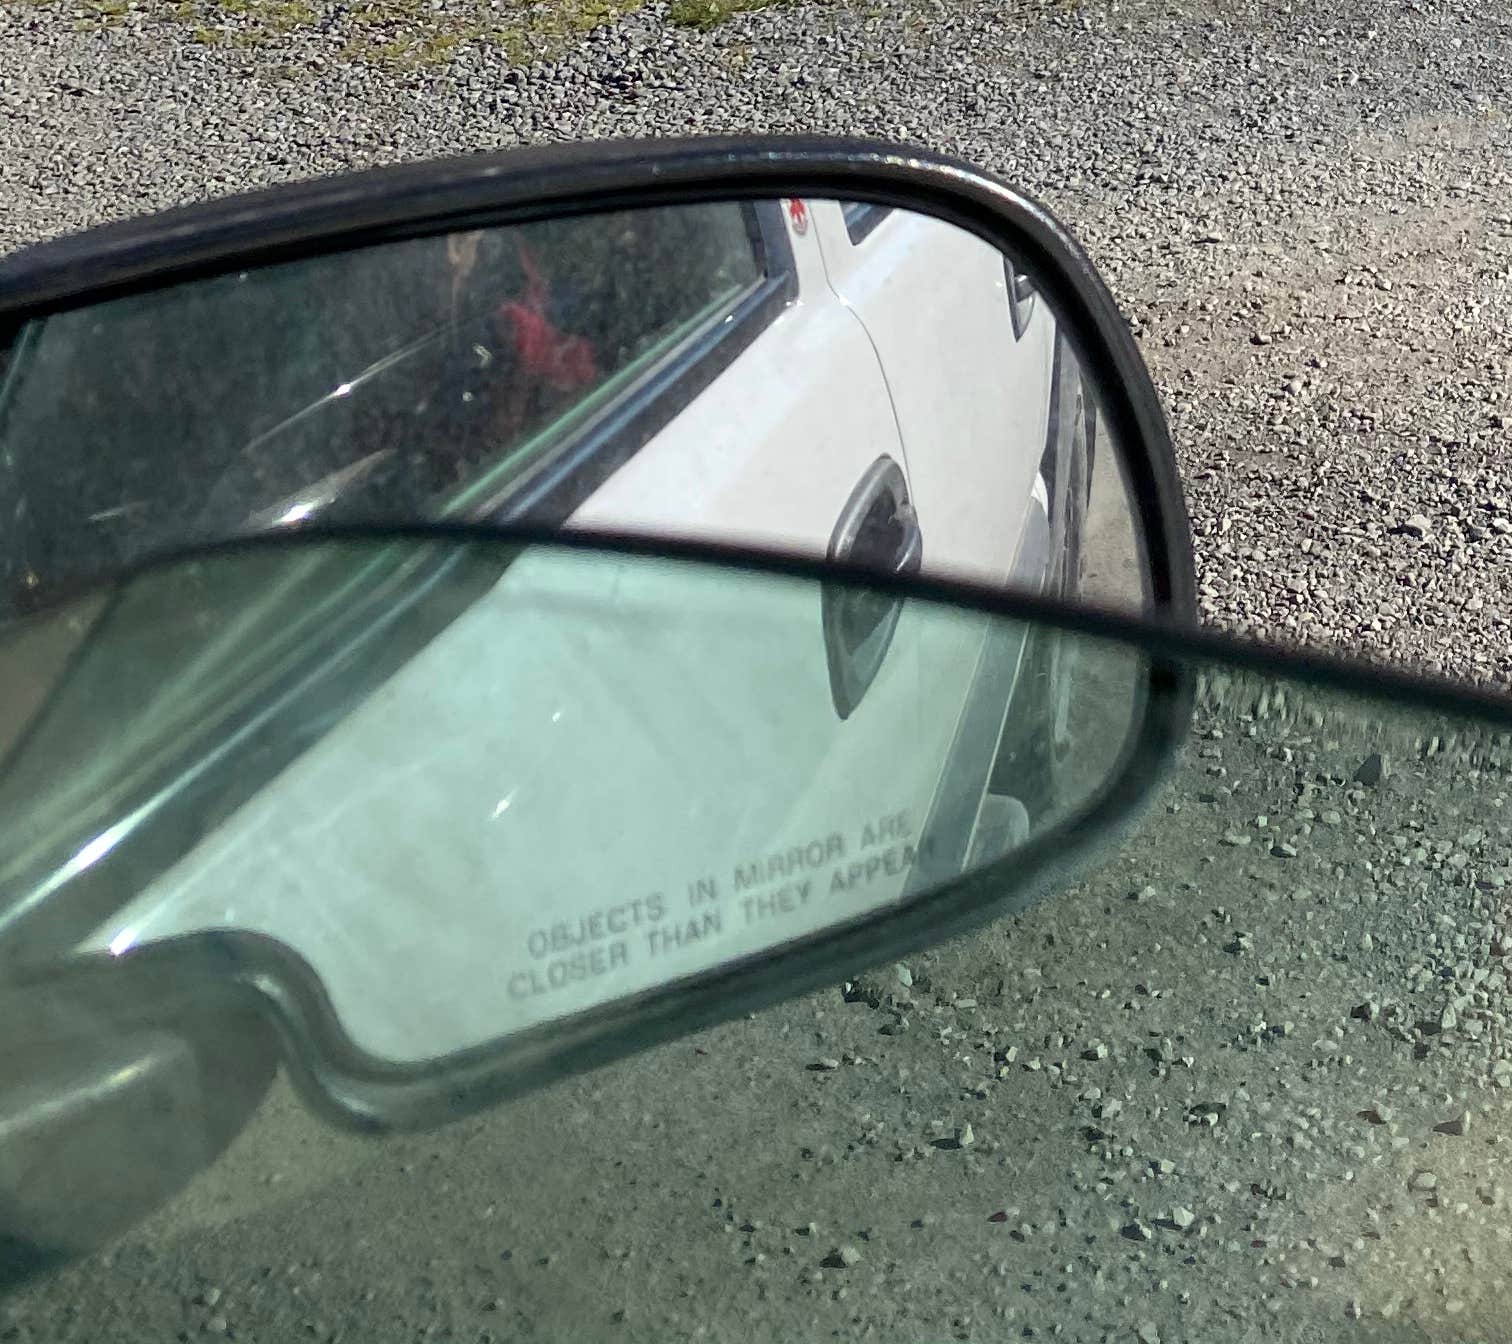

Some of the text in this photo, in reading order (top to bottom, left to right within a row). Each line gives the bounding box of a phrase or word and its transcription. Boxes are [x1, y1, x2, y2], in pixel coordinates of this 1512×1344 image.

[506, 942, 630, 1002] CLOSER
[646, 907, 722, 959] THAN
[736, 877, 813, 926] THEY
[526, 812, 913, 961] OBJECTS IN MIRROR ARE
